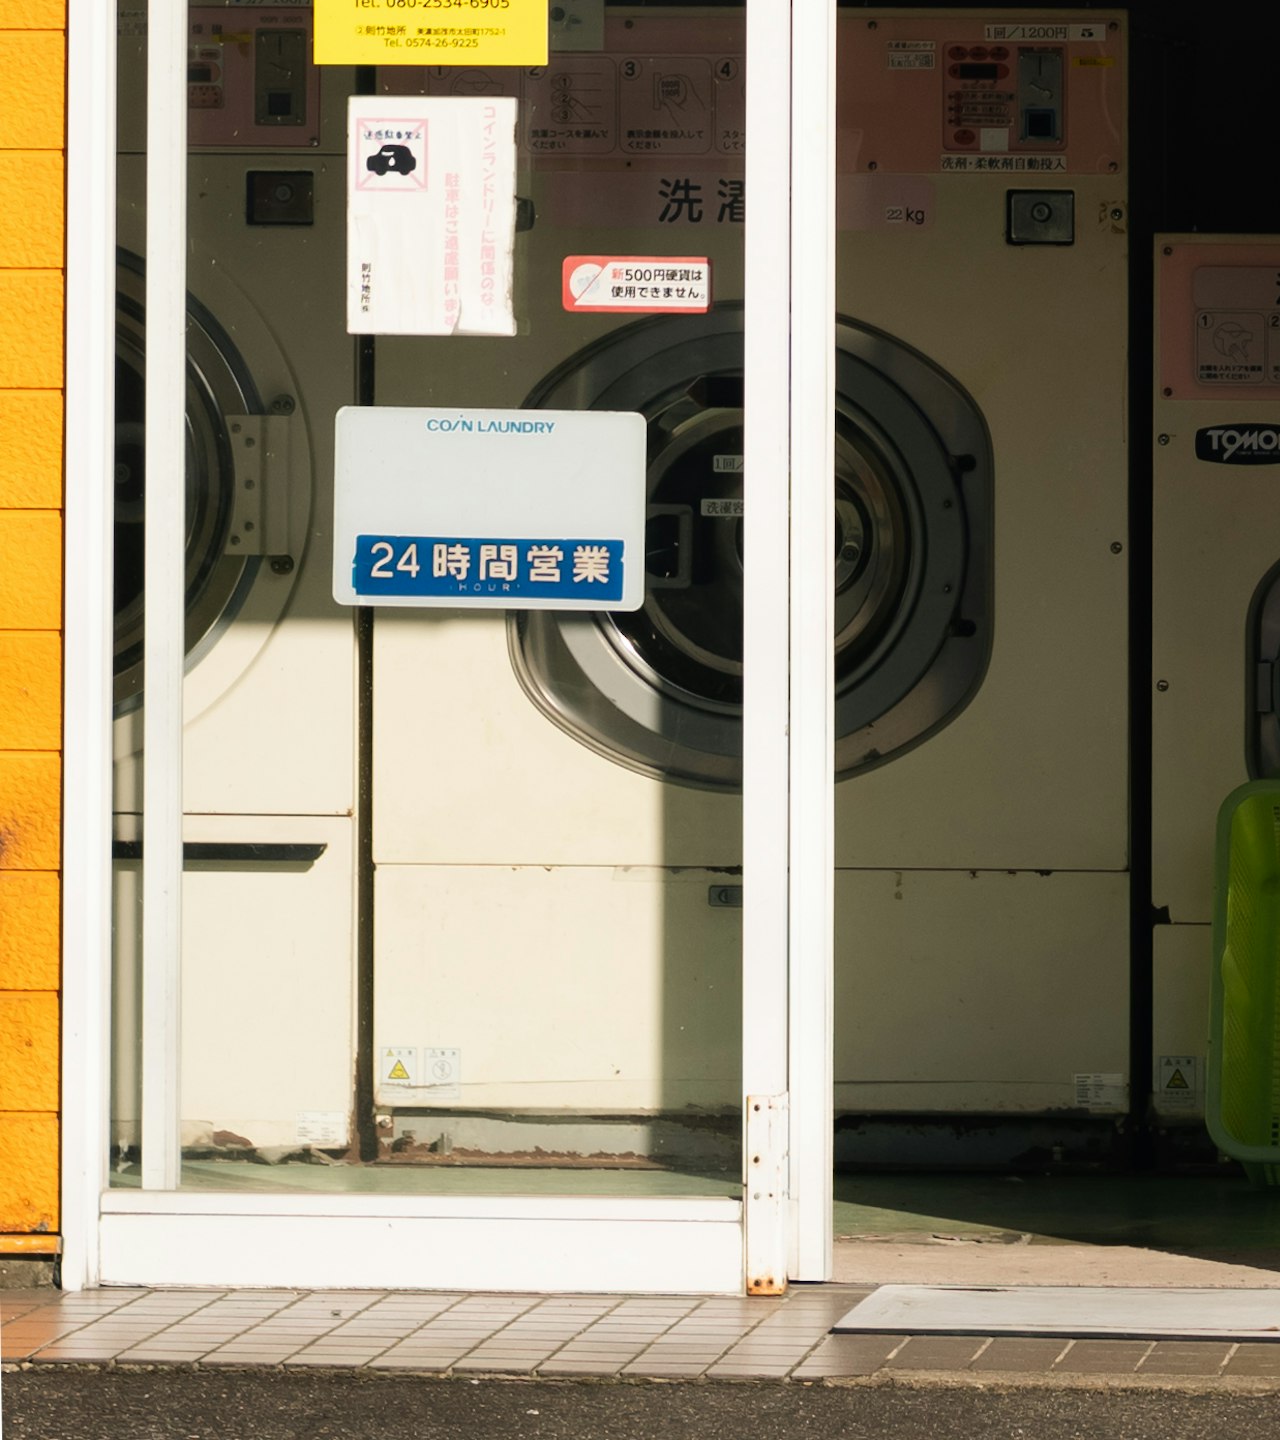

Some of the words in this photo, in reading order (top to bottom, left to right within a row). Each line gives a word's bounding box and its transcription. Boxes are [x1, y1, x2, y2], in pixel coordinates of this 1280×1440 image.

[1081, 28, 1093, 37] 5
[384, 39, 402, 48] Tel.
[405, 39, 478, 48] 0574-26-9225
[625, 62, 635, 76] 3
[720, 62, 730, 77] 4
[532, 140, 567, 149] ください
[627, 140, 661, 149] ください
[942, 157, 1068, 170] 洗剤・柔軟剤自動投入
[611, 268, 703, 282] 新500円硬貨は
[611, 286, 705, 298] 使用できません。
[1201, 316, 1208, 326] 1
[1272, 316, 1280, 327] 2
[427, 415, 473, 432] COIN
[478, 421, 555, 434] LAUNDRY
[370, 542, 610, 584] 24時間営業
